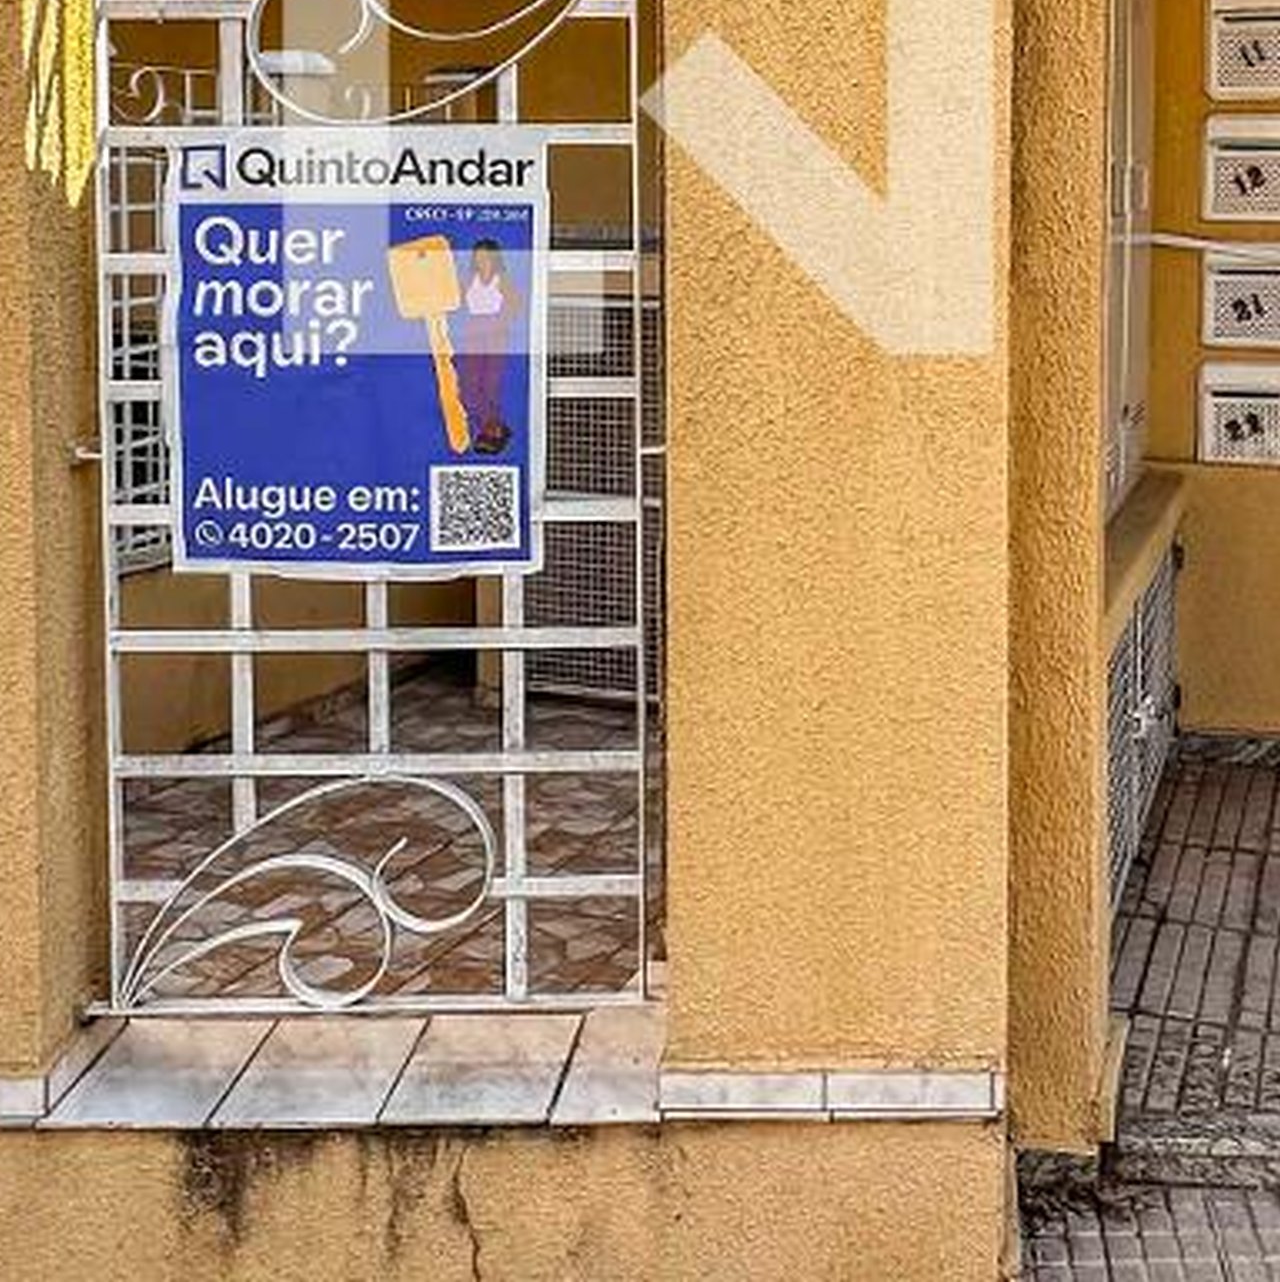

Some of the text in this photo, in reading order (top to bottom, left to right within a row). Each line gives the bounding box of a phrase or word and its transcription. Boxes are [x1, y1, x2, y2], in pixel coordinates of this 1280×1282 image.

[236, 147, 534, 187] QuintoAndar
[1232, 166, 1267, 196] 12
[194, 216, 345, 267] Quer
[193, 276, 373, 317] morar
[1231, 293, 1265, 324] 21
[194, 318, 358, 378] aqui?
[194, 477, 420, 518] Alugue em:
